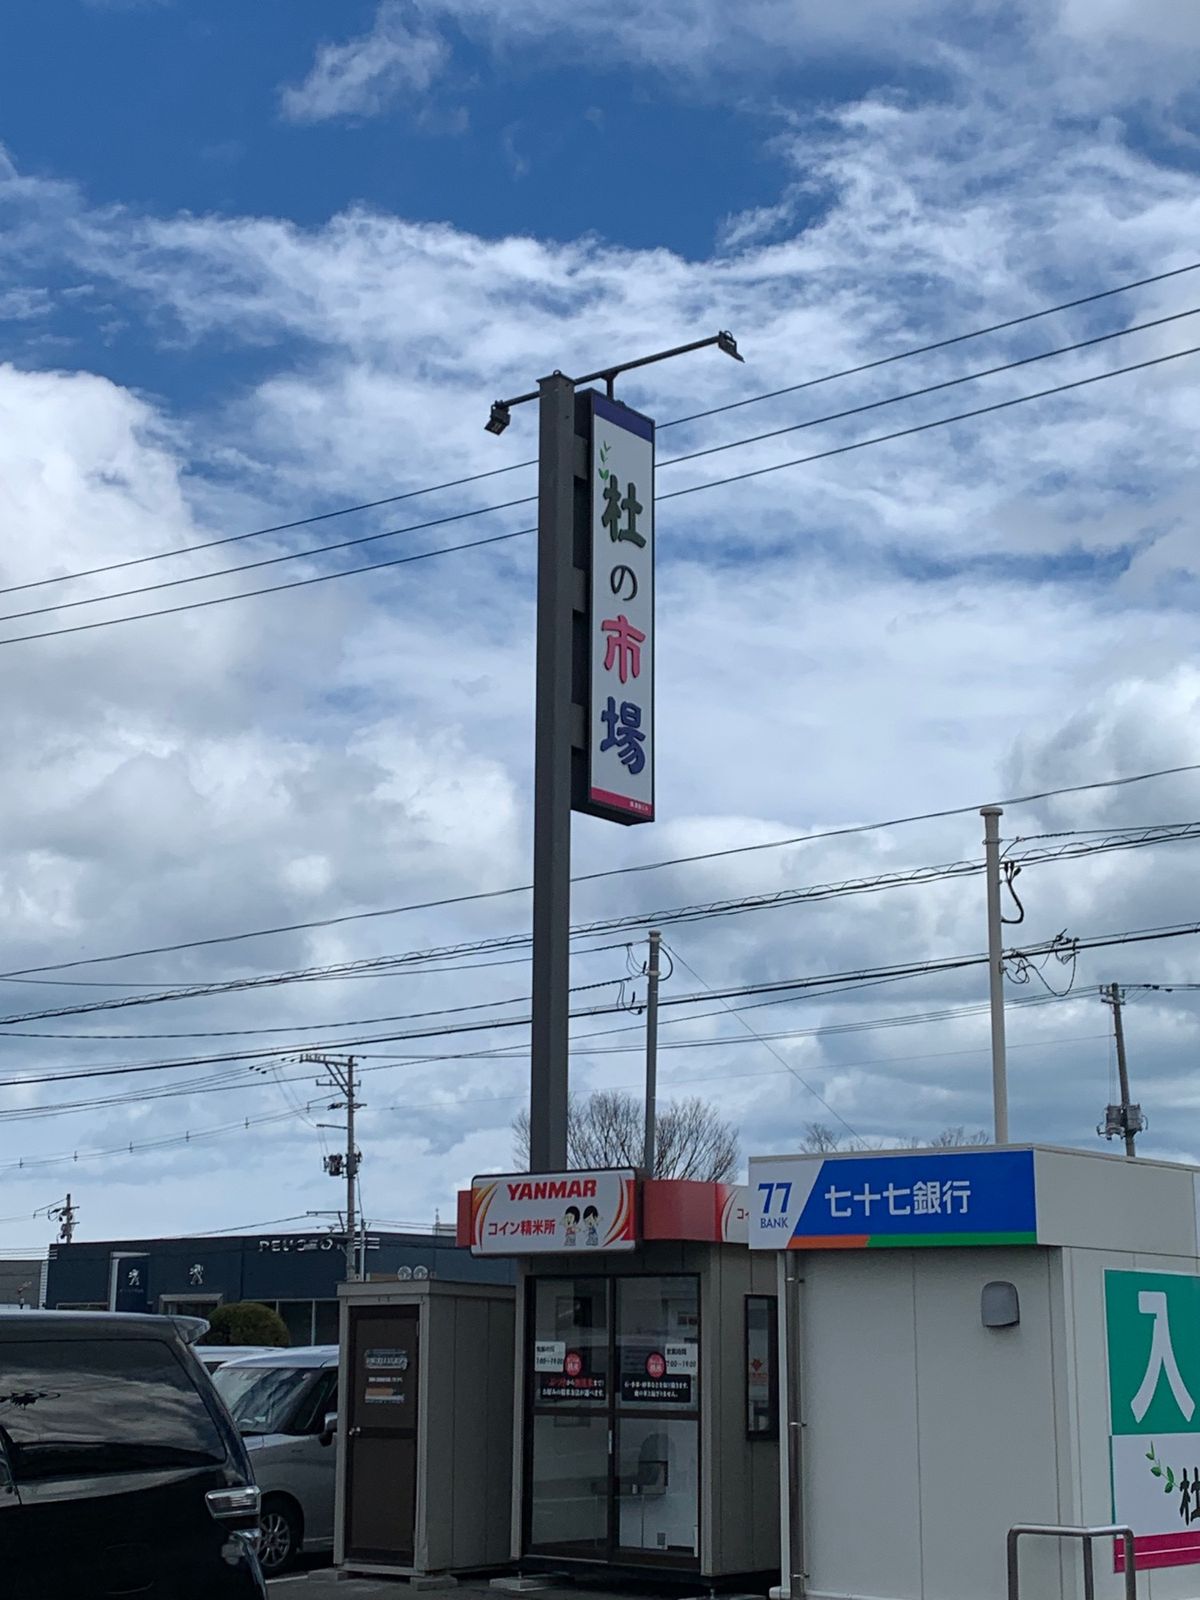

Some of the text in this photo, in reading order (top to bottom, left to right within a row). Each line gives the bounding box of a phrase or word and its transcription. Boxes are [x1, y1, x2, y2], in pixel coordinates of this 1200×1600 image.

[600, 474, 647, 775] 杜の市場
[507, 1180, 597, 1201] YANMAR
[757, 1182, 793, 1214] 77
[825, 1180, 972, 1217] 七十七銀行
[488, 1219, 556, 1236] コイン精米所
[760, 1217, 789, 1229] BANK
[1130, 1291, 1196, 1424] 入
